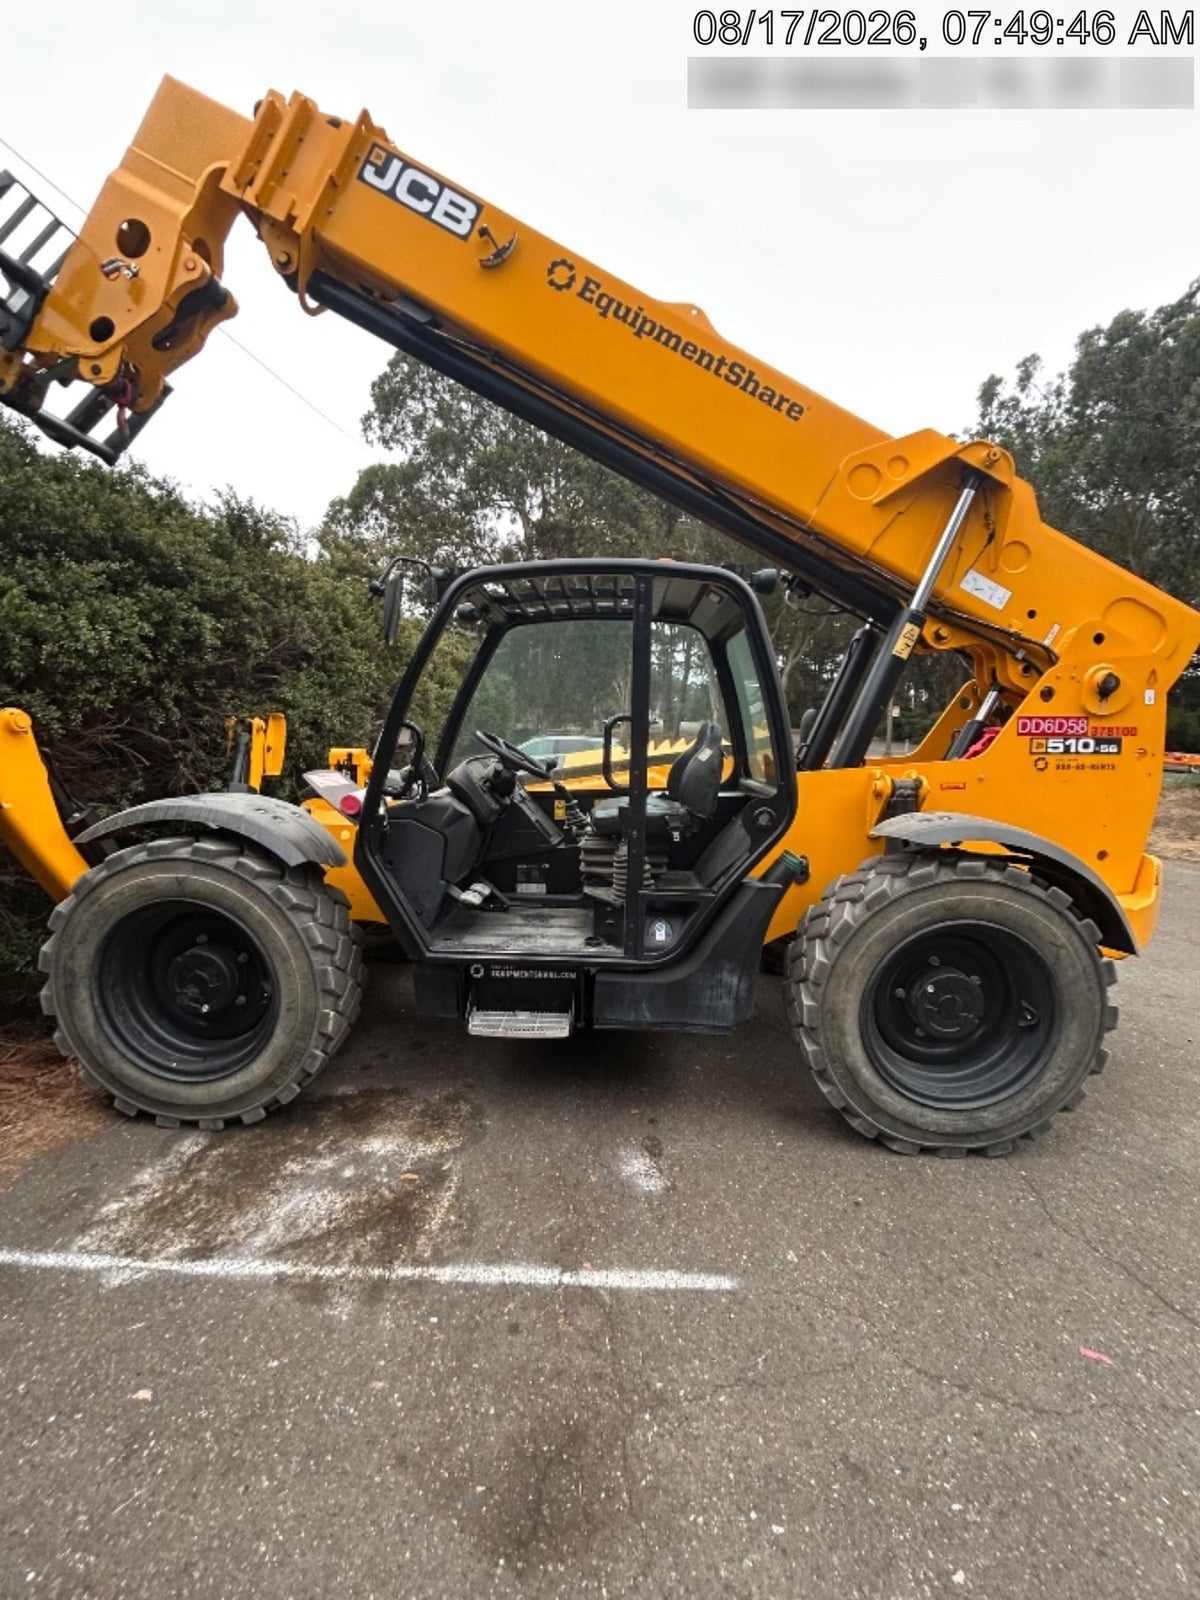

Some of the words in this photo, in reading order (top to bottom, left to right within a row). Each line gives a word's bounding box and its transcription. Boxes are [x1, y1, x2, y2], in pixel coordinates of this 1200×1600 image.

[363, 157, 478, 236] JCB
[575, 276, 805, 422] EquipmentShare
[1017, 717, 1089, 735] DD6D58
